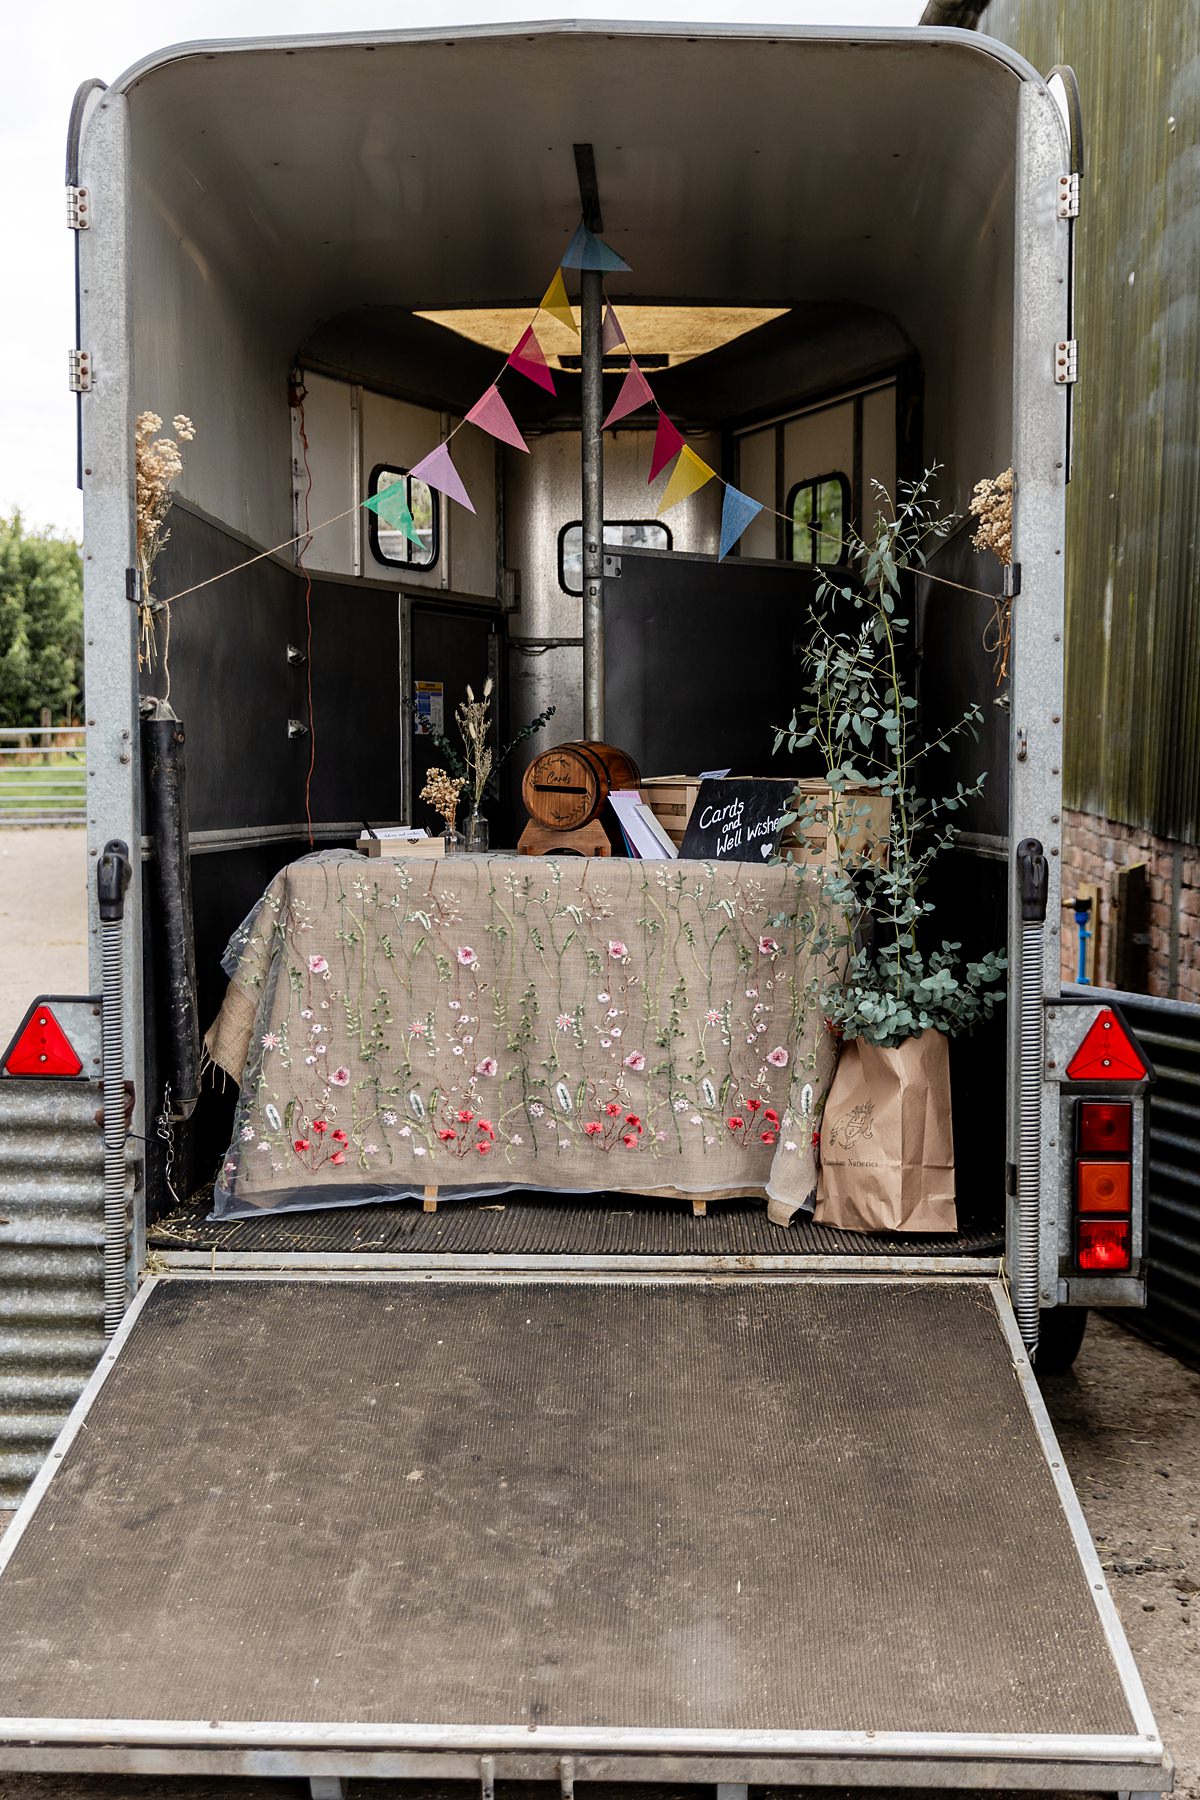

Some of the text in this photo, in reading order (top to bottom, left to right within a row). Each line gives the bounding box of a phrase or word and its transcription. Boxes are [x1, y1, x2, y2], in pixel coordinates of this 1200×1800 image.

[547, 771, 572, 784] Cards
[700, 798, 744, 829] Cards
[722, 815, 742, 833] and
[716, 816, 783, 857] Well Wishe
